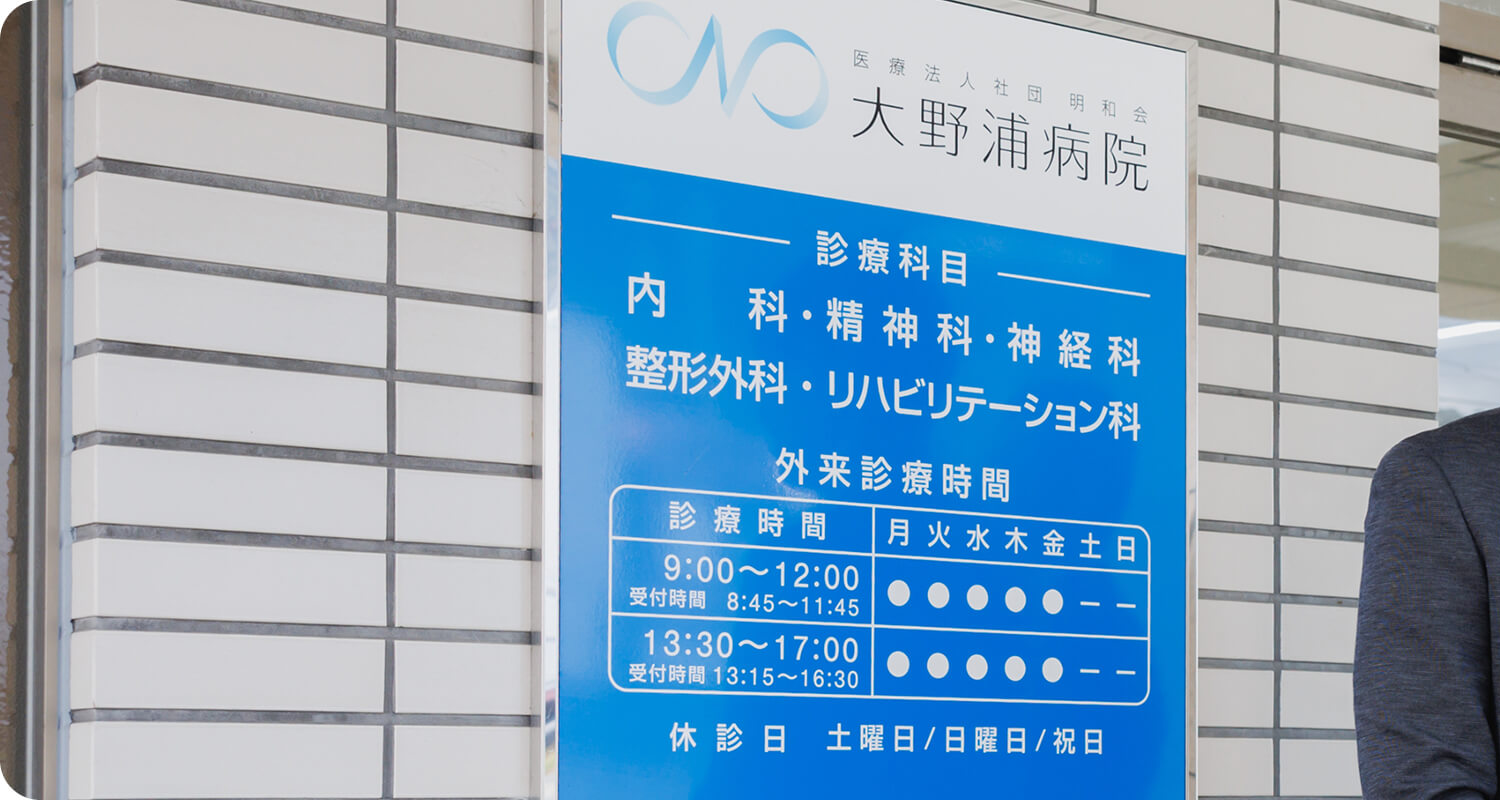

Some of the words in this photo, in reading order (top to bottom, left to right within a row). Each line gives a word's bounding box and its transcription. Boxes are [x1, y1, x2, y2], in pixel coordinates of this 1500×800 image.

[853, 49, 1042, 104] 医療法人社団
[1070, 92, 1148, 124] 明和会
[852, 86, 1149, 192] 大野浦病院
[816, 230, 967, 287] 診療科目
[773, 447, 1010, 503] 外来診療時間
[669, 500, 826, 541] 診療時間
[664, 553, 859, 591] 9:00～12:00
[629, 586, 706, 610] 受付時間
[727, 591, 859, 618] 8:45～11:45
[644, 629, 858, 663] 13:30～17:00
[629, 662, 706, 685] 受付時間
[712, 666, 859, 690] 13:15～16:30
[669, 721, 786, 753] 休診日
